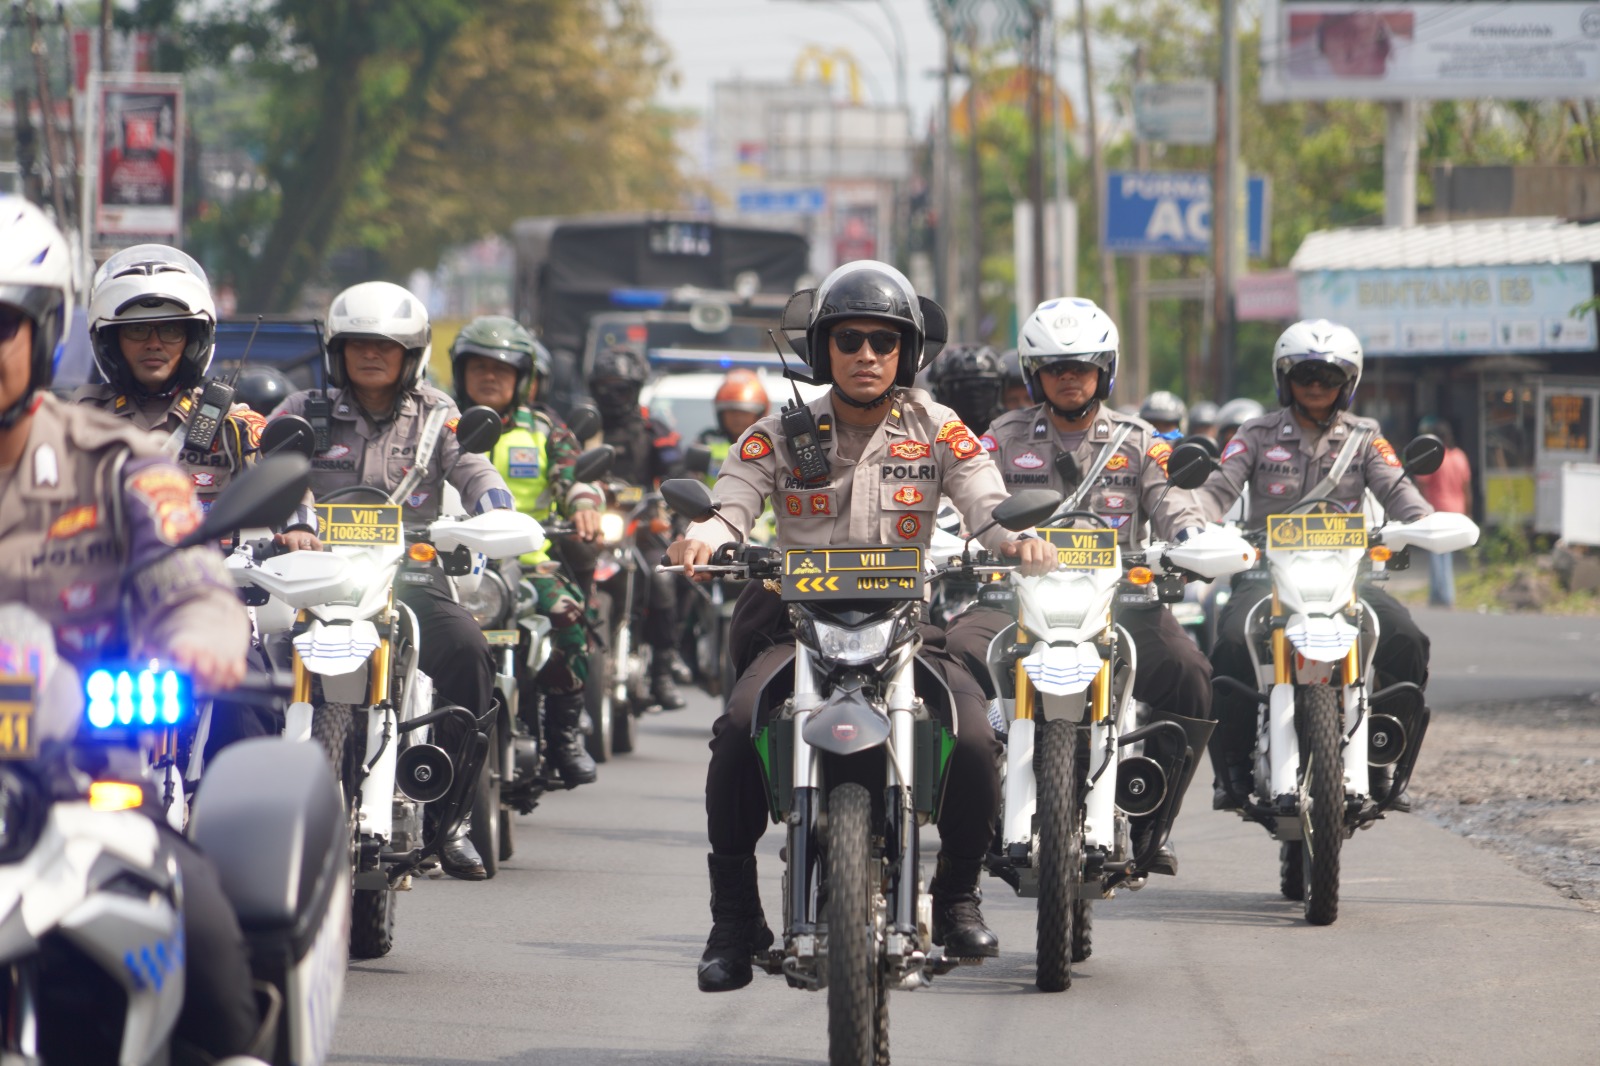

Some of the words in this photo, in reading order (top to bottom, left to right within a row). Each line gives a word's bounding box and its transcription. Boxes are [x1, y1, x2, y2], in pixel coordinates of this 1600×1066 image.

[882, 465, 936, 479] POLRI
[351, 509, 379, 524] VIII
[1323, 517, 1347, 530] VIII
[332, 526, 395, 541] 100265-12
[1071, 534, 1098, 549] VIII
[860, 553, 886, 566] VIII
[1057, 551, 1112, 565] 00261-12
